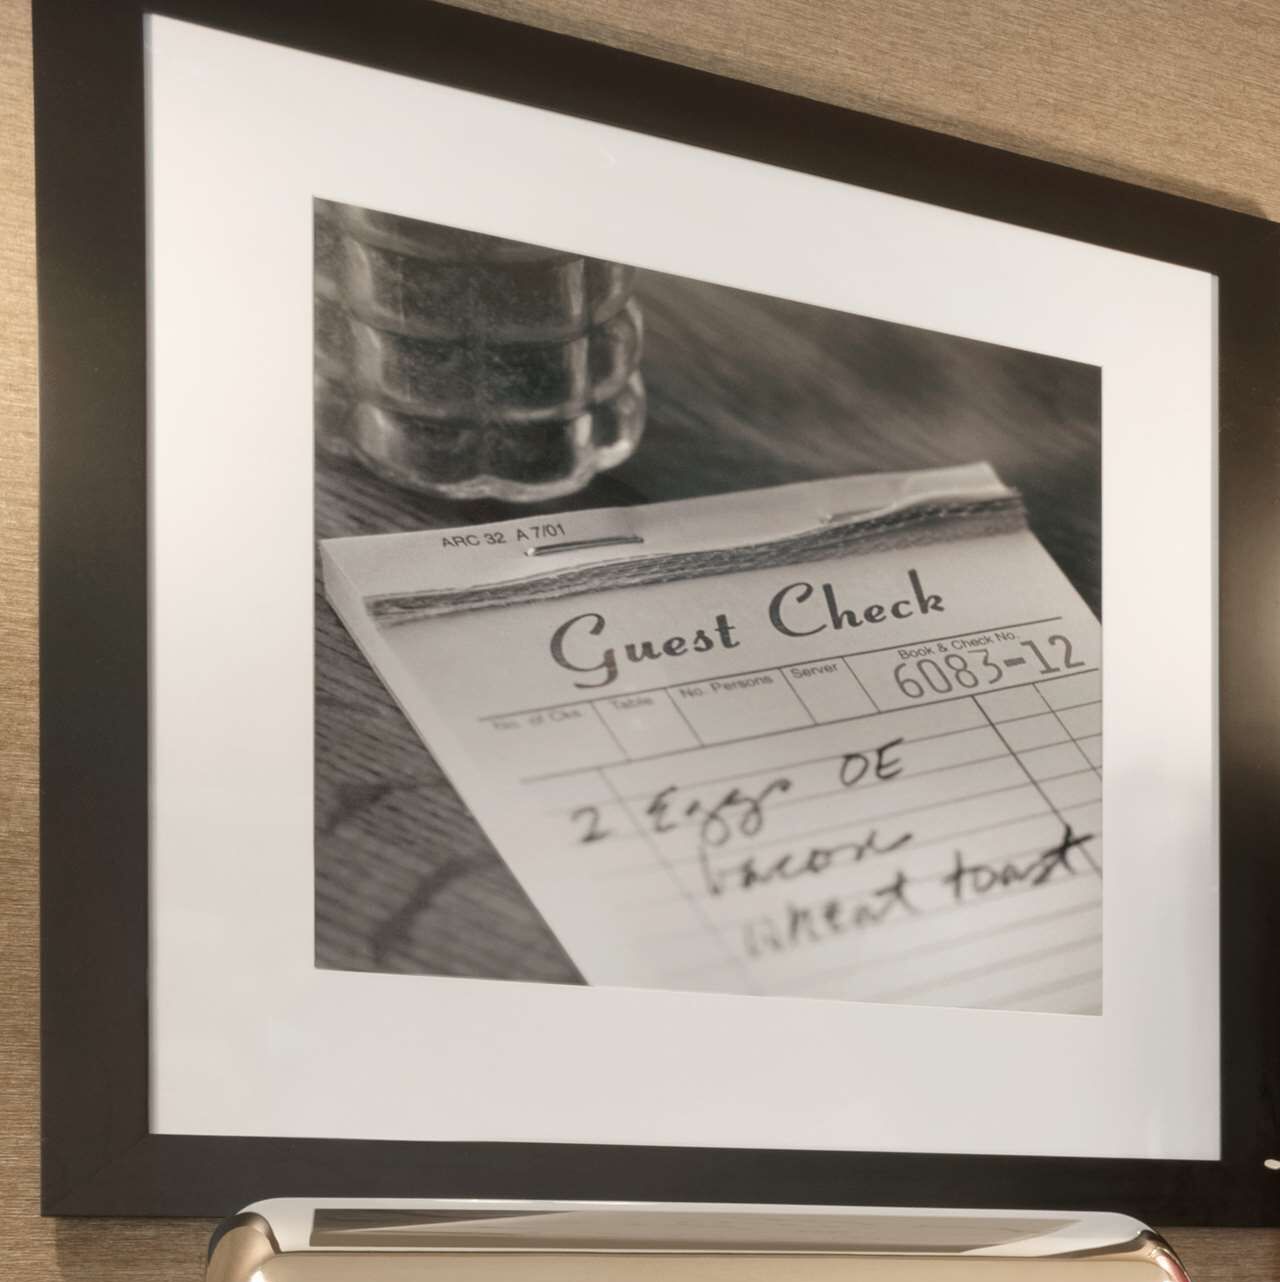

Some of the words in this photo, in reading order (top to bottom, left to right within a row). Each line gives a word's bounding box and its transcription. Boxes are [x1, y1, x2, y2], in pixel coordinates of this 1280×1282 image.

[441, 533, 481, 549] ARC
[483, 531, 506, 547] 32
[515, 527, 531, 542] A
[532, 523, 567, 538] 7/01
[549, 611, 741, 690] Guest
[767, 568, 947, 638] Check
[897, 646, 935, 660] Book
[937, 642, 949, 652] &
[951, 634, 994, 650] Check
[710, 674, 774, 695] Persons
[790, 661, 840, 679] Server
[894, 633, 1086, 699] 6083-12
[571, 804, 612, 845] 2
[644, 777, 793, 846] Eggs
[838, 737, 905, 788] OE
[942, 821, 1097, 900] toast
